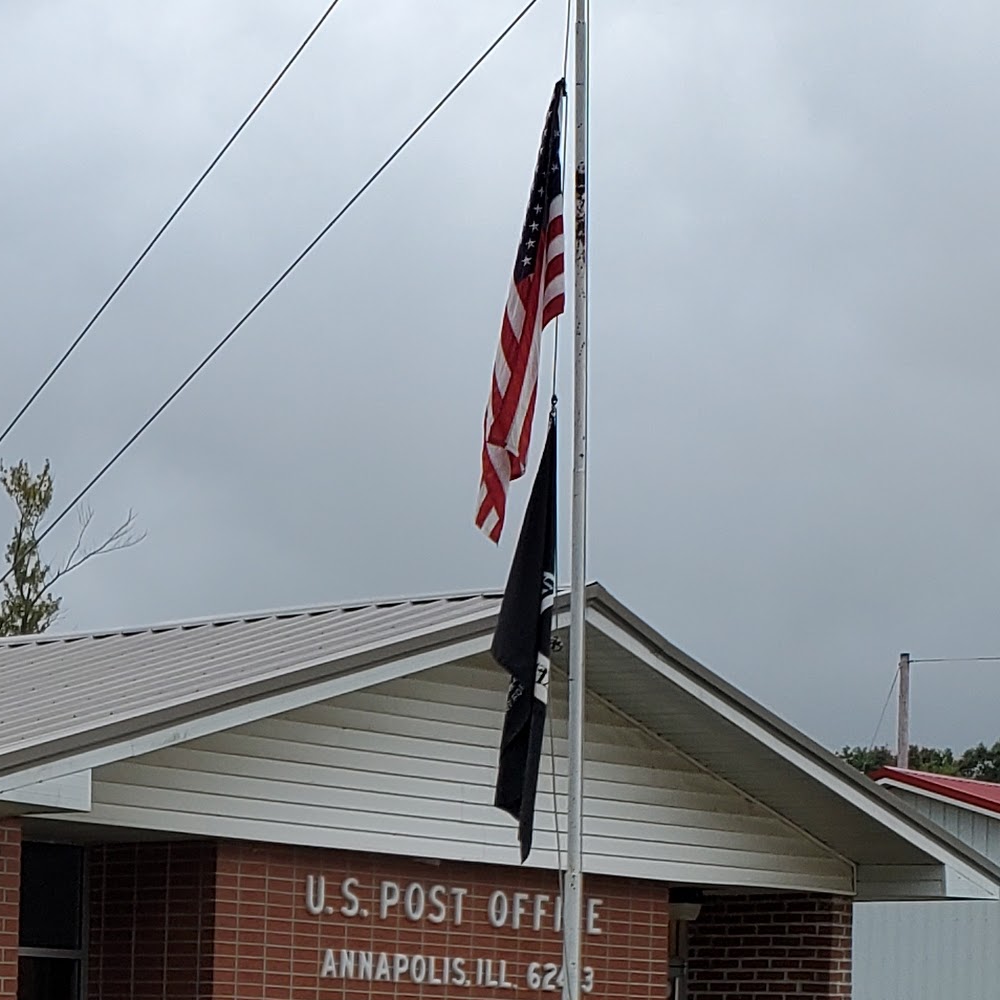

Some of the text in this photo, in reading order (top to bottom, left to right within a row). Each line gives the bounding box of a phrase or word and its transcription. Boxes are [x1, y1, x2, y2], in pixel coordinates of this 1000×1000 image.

[380, 881, 467, 926] POST
[488, 890, 603, 935] OFFIE
[526, 961, 594, 993] 623
